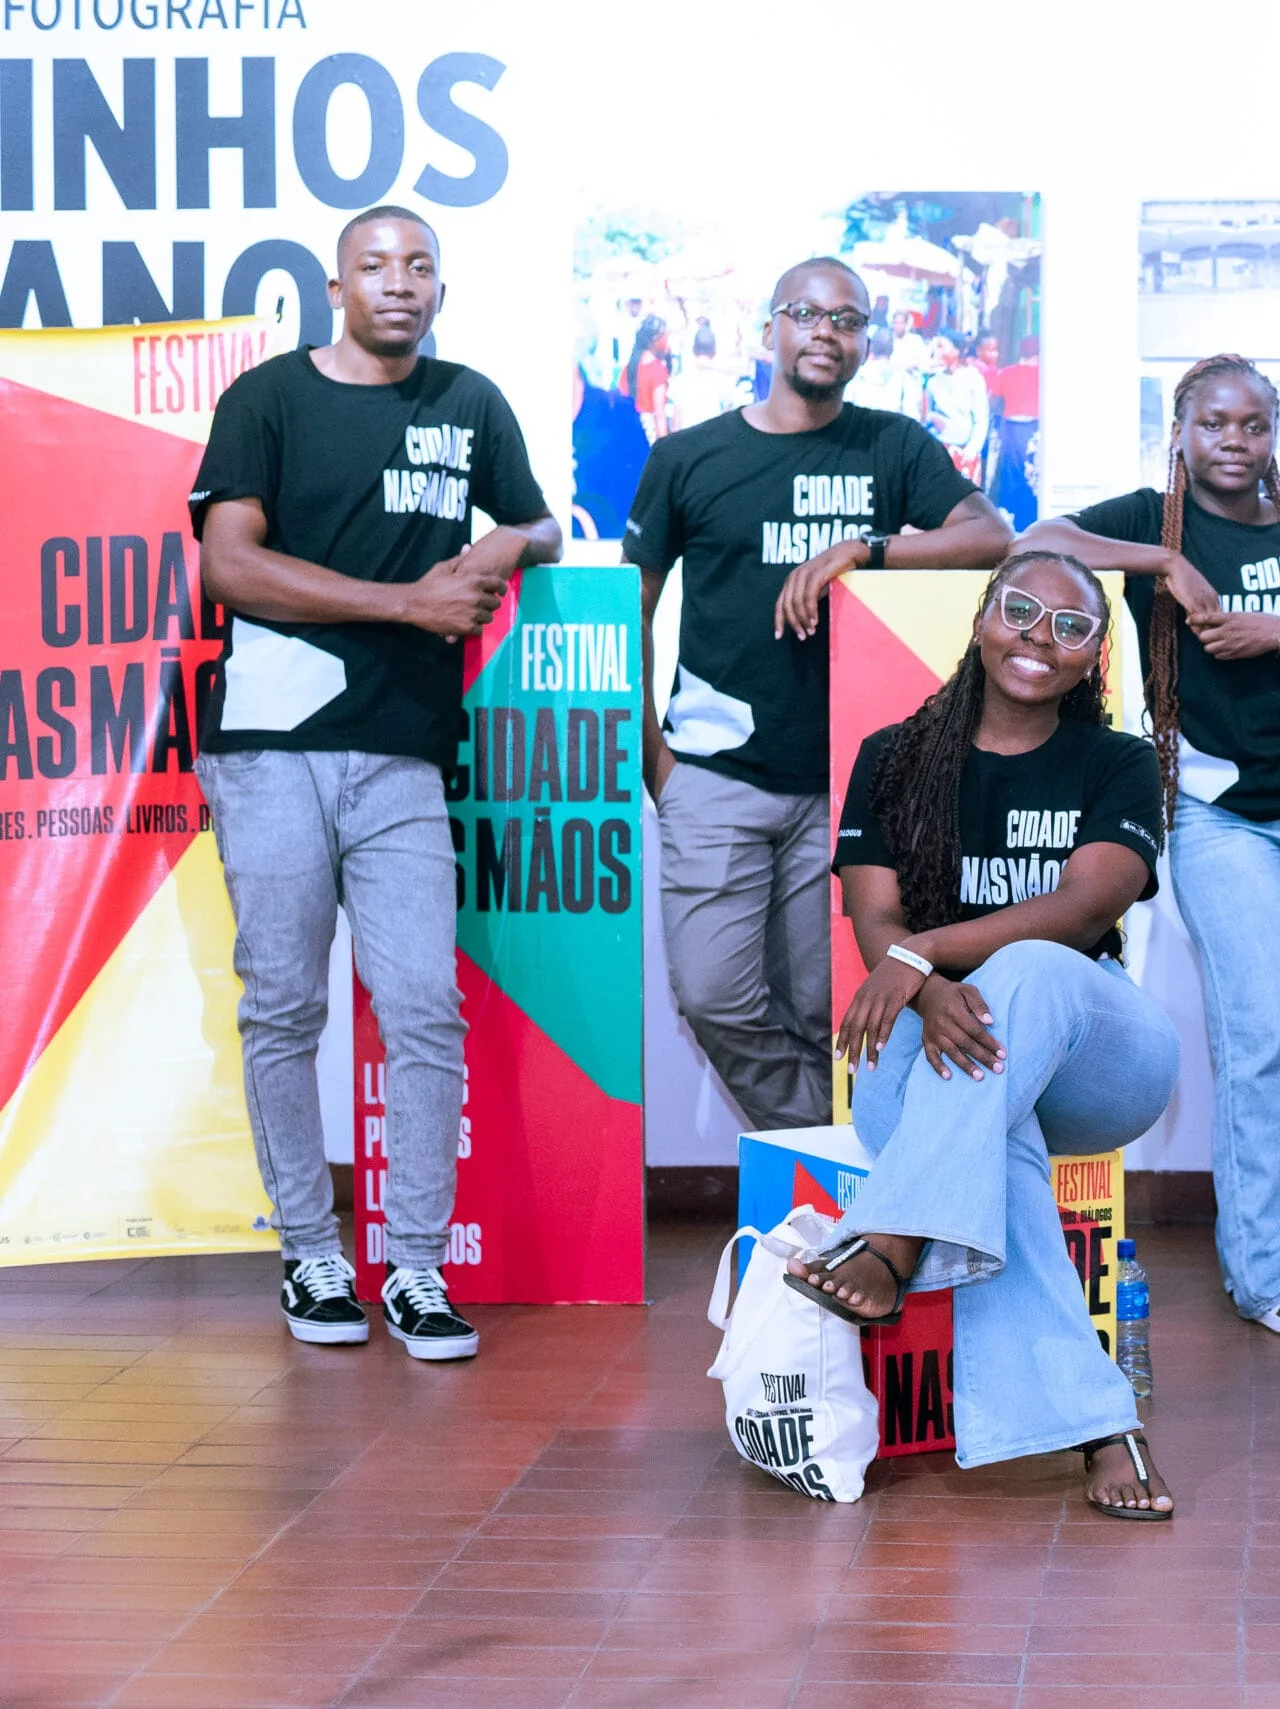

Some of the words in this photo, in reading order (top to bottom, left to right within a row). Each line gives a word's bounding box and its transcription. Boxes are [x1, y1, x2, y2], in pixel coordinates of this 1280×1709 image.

[0, 51, 509, 209] INHOS
[0, 239, 437, 358] ANO
[405, 423, 475, 472] CIDADE
[793, 474, 875, 517] CIDADE
[808, 518, 873, 561] MÃ
[40, 530, 224, 648] CIDA
[521, 623, 632, 692] FESTIVAL
[90, 647, 225, 776] MÃ
[1007, 809, 1082, 849] CIDADE
[477, 806, 632, 914] MÃOS
[1007, 852, 1068, 904] MÃO
[1057, 1159, 1112, 1203] FESTIVAL
[760, 1372, 807, 1404] FESTIVAL
[735, 1415, 814, 1468] CIDADE
